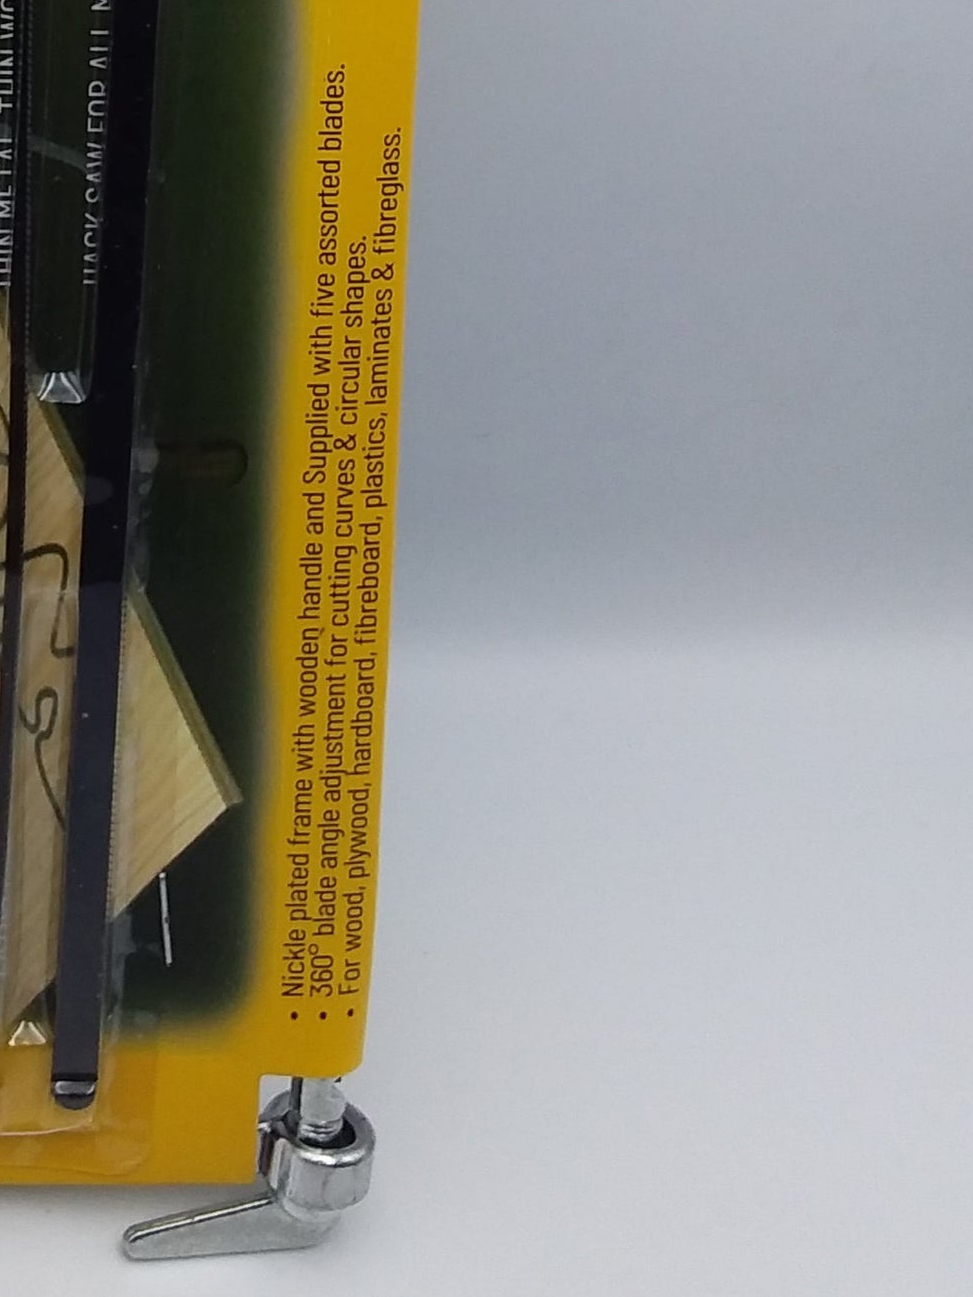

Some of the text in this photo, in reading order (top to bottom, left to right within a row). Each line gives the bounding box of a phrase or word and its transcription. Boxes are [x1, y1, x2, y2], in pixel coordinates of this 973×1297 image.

[281, 63, 346, 997] Nickle plated frame with wooden handle and Supplied with five assorted blades.
[308, 235, 370, 997] 360° blade angle adjustment for cutting curves & circular shapes.
[338, 127, 404, 995] For wood, plywood, hardboard, fibreboard, plastics, laminates & fibreglass.
